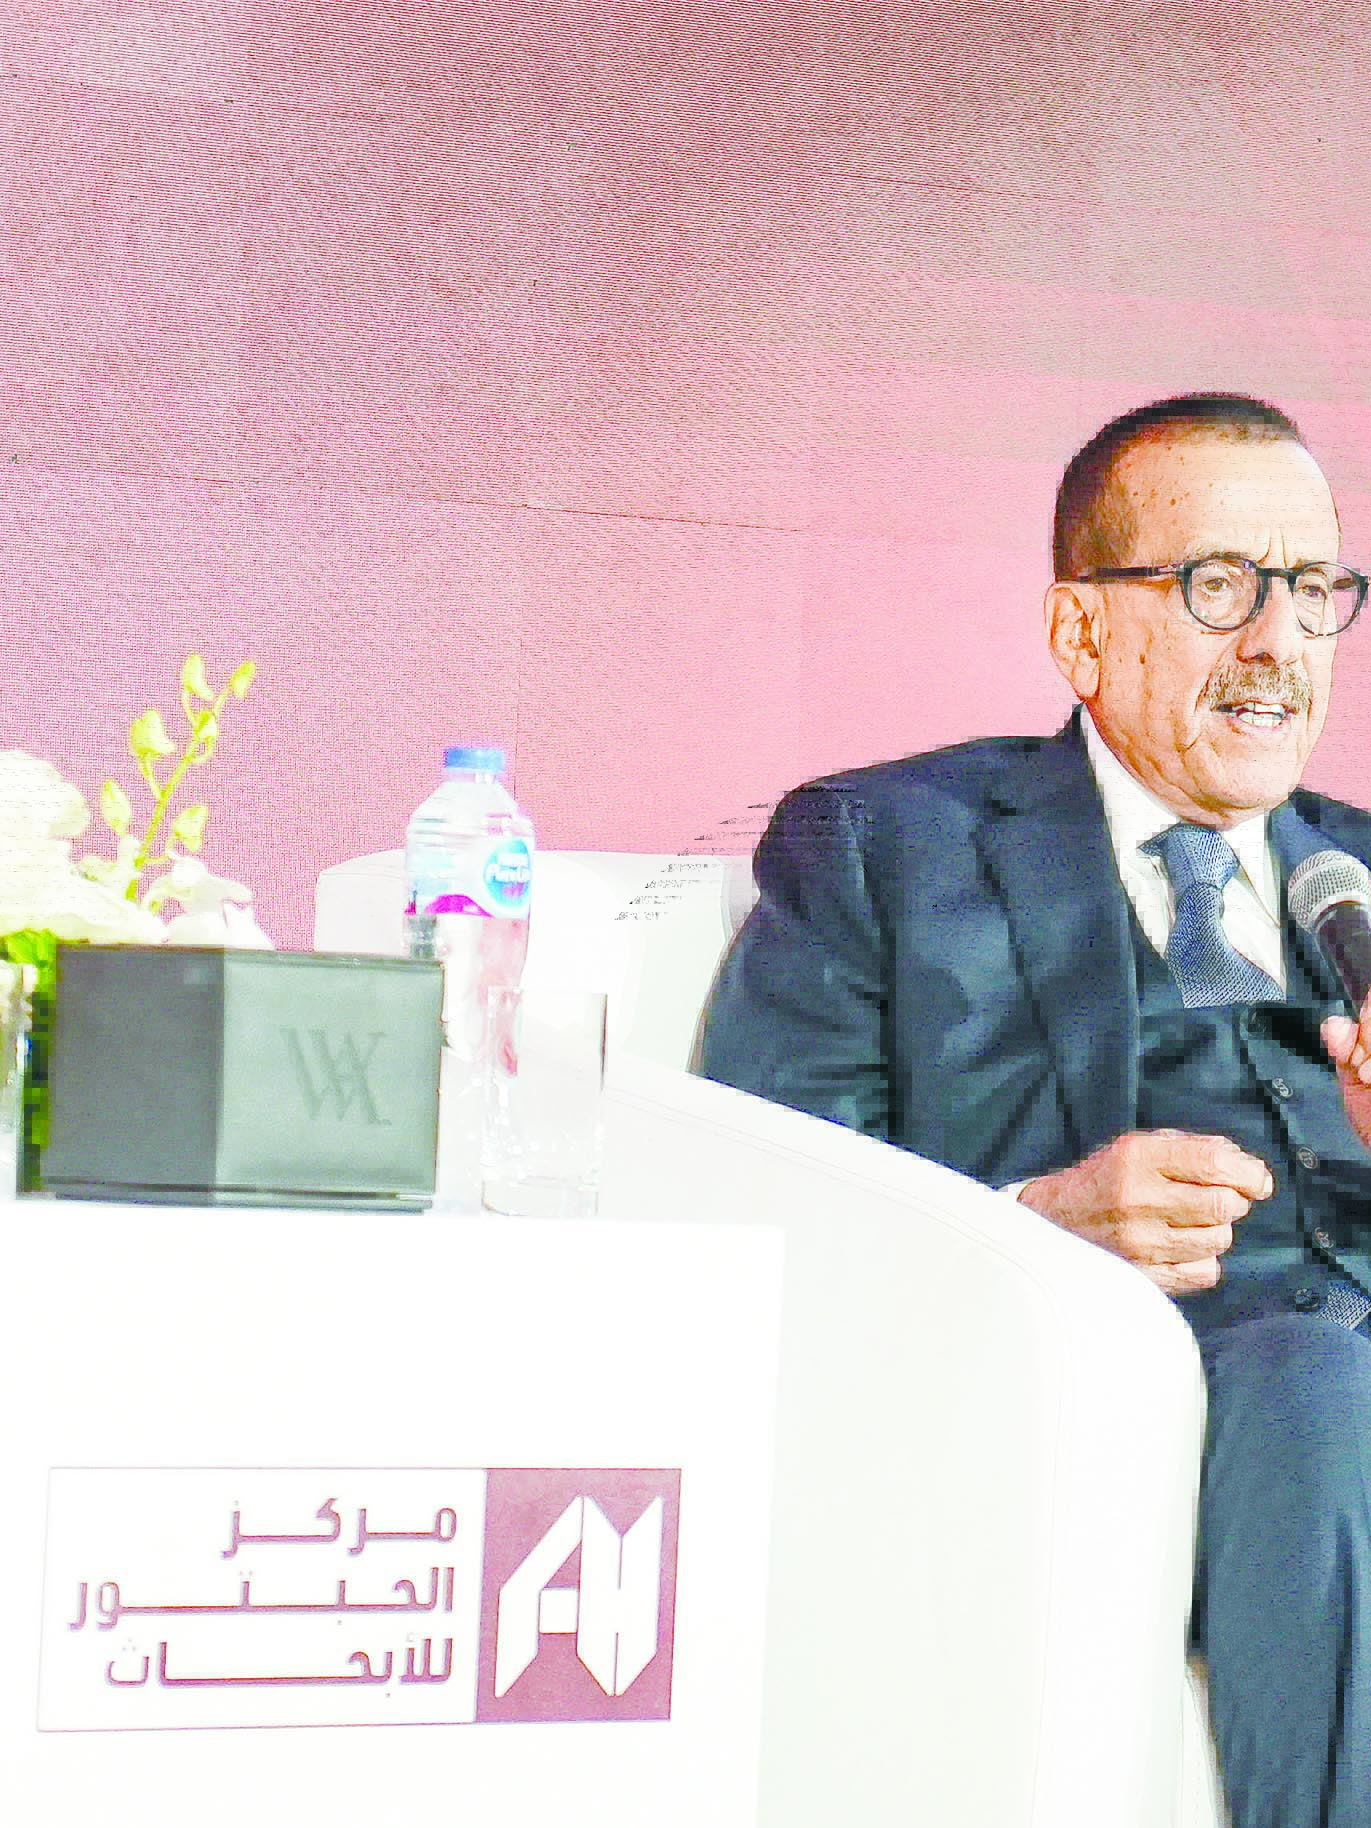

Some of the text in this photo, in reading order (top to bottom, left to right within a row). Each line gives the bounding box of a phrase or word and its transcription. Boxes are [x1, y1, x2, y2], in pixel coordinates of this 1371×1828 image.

[221, 1497, 458, 1561] مركز
[68, 1566, 456, 1632] الحبتور
[105, 1634, 453, 1698] للأبحاث
